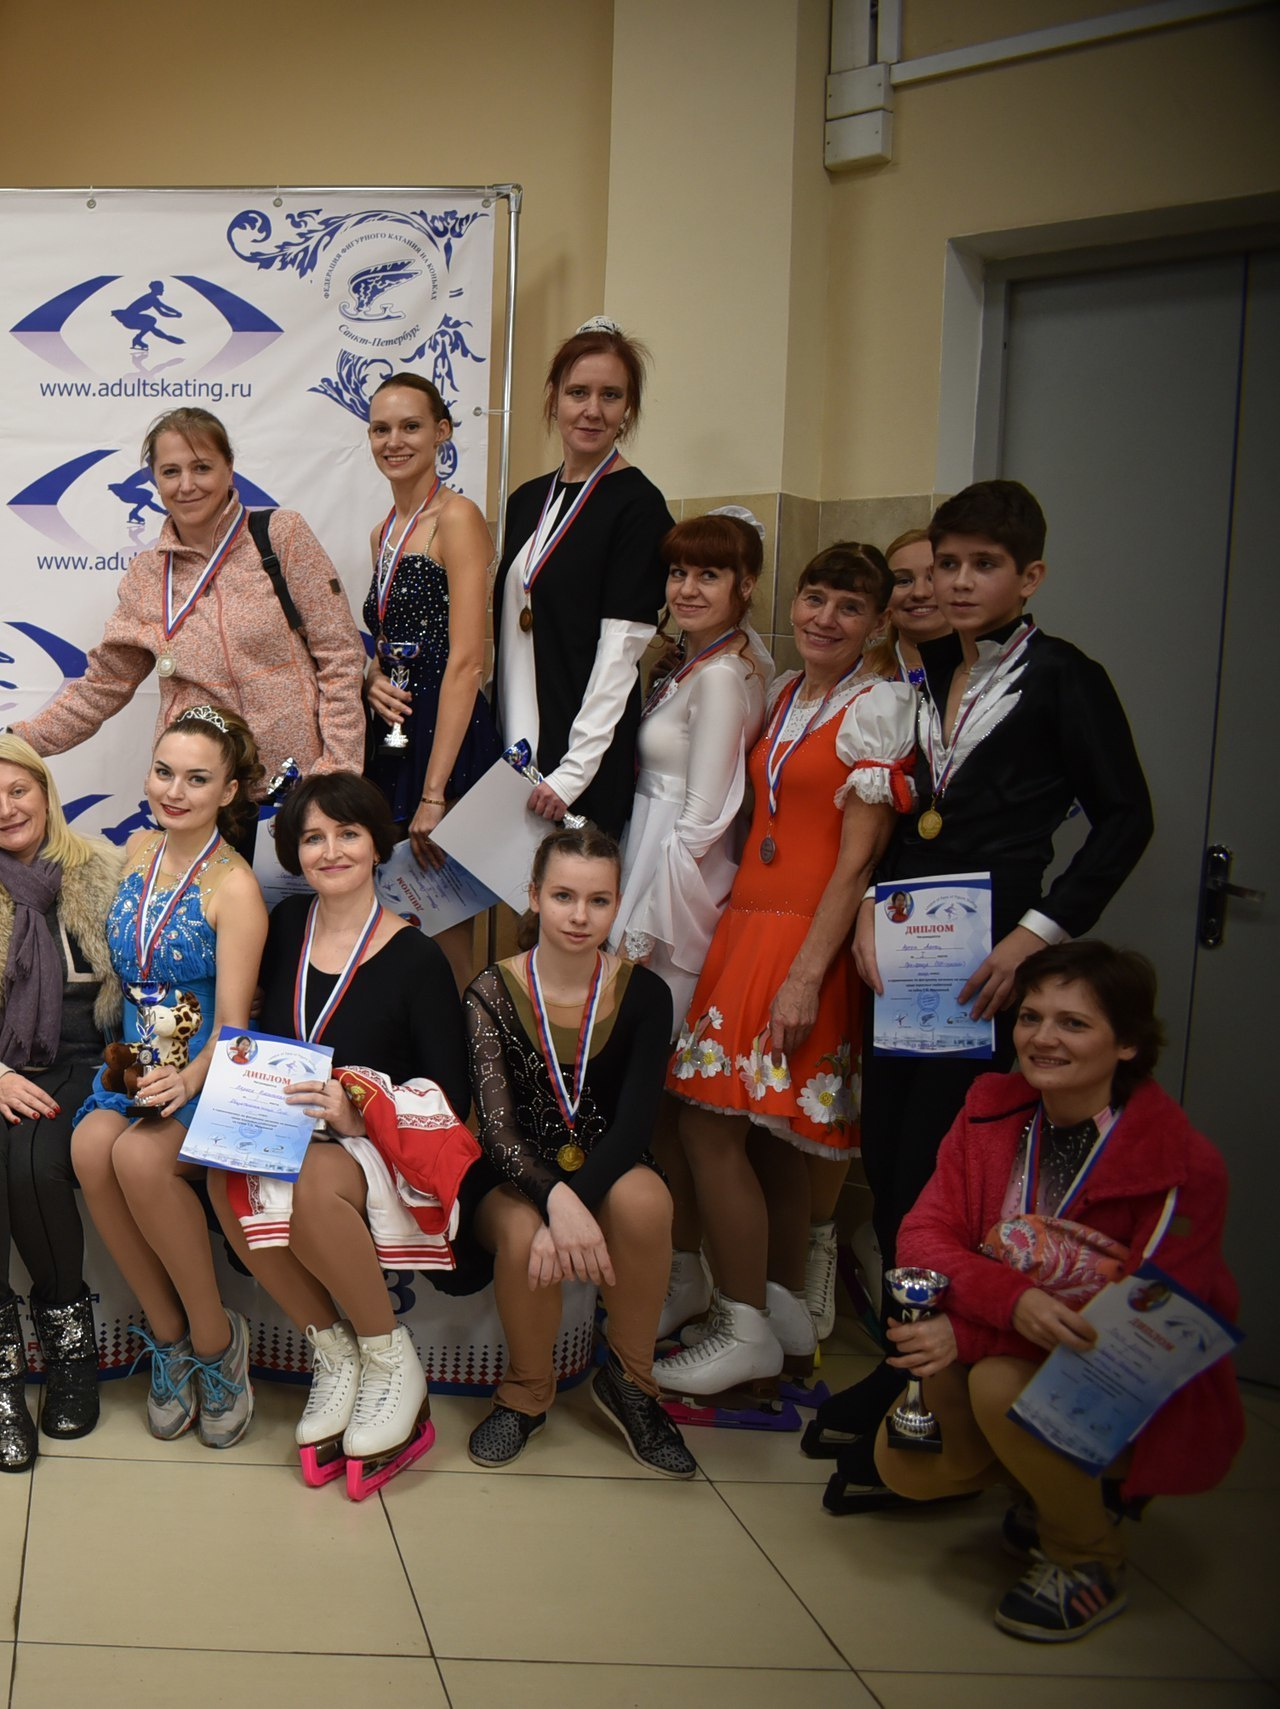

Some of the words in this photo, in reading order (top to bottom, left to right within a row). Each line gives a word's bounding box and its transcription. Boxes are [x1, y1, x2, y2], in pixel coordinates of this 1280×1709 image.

[338, 324, 421, 347] Санкт-Петербург
[40, 378, 252, 402] www.adultskating.ru
[905, 924, 955, 935] ДИПЛОМ
[242, 1069, 292, 1086] ДИПЛОМ
